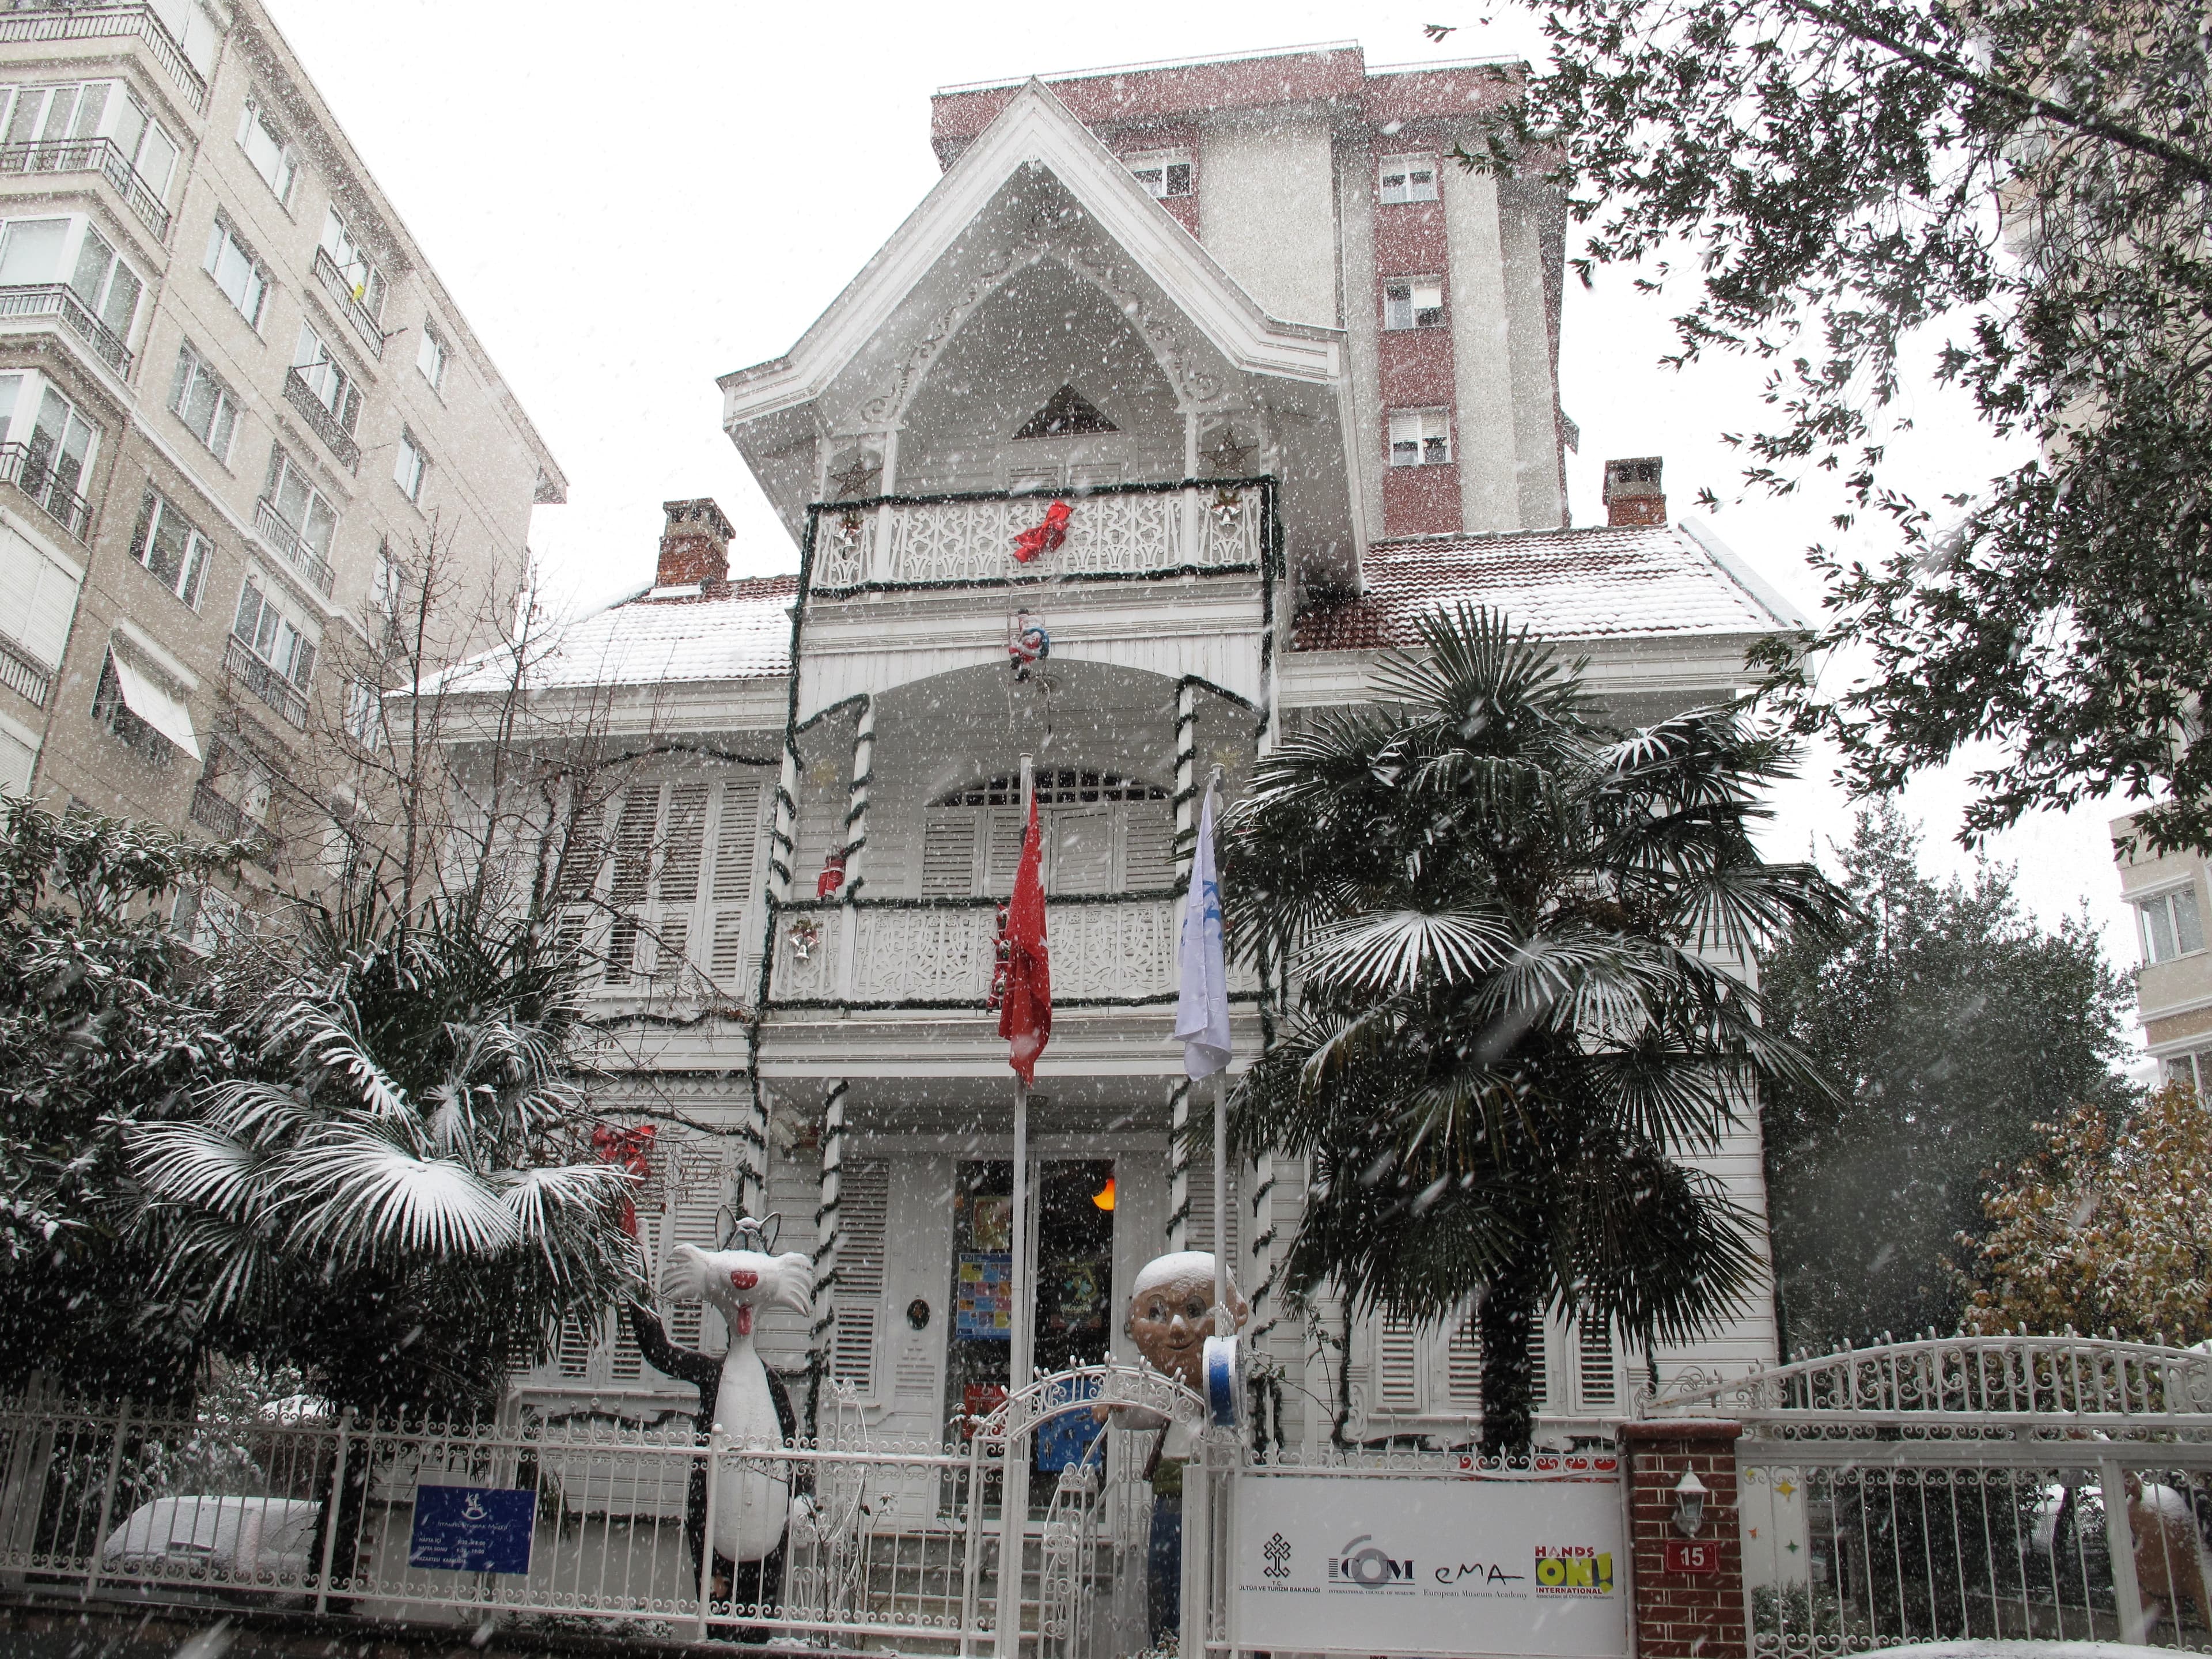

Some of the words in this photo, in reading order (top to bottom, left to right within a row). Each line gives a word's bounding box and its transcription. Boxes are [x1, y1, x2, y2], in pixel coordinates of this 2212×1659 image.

[1535, 1546, 1594, 1557] HANDS
[1680, 1547, 1704, 1566] 15
[1328, 1548, 1415, 1589] ICOM
[1537, 1552, 1613, 1594] ON!
[1423, 1589, 1459, 1598] European
[1495, 1590, 1527, 1600] Academy
